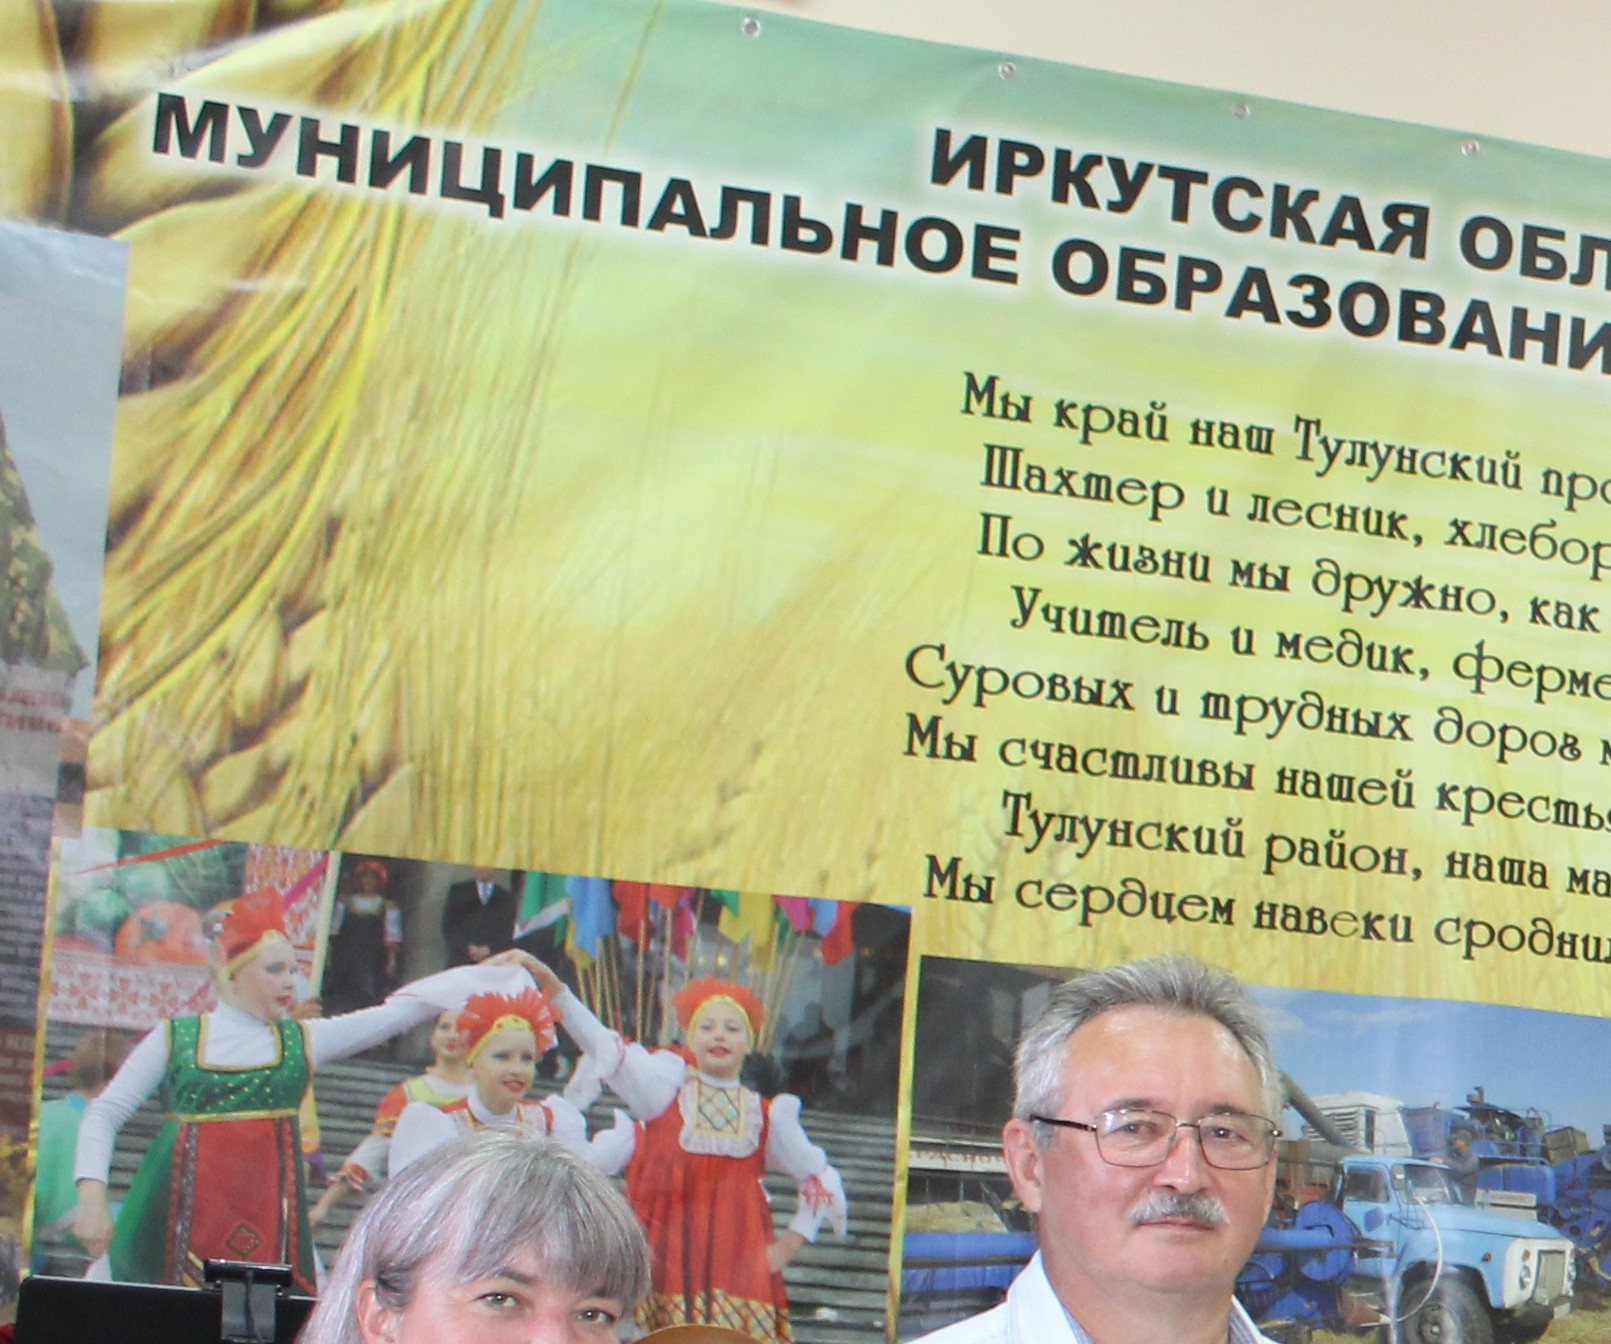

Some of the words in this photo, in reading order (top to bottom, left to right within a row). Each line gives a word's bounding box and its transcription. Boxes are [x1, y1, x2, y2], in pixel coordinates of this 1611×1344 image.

[153, 92, 1021, 286] МУНИЦИПАЛЬНОЕ
[930, 127, 1430, 261] ИРКУТСКАЯ
[960, 370, 1034, 424] Мы
[1052, 398, 1170, 447] край
[1188, 418, 1275, 456] наш
[1293, 413, 1523, 491] Тулунский
[979, 442, 1186, 523] Шахтер
[1205, 485, 1230, 518] и
[1246, 493, 1423, 548] лесник,
[976, 511, 1045, 562] По
[1063, 532, 1212, 584] жизни
[1228, 558, 1291, 593] мы
[1311, 557, 1509, 624] дружно,
[1528, 595, 1601, 634] как
[1009, 584, 1210, 652] Учитель
[1230, 625, 1256, 656] и
[1274, 627, 1430, 682] медик,
[904, 643, 1136, 712] Суровых
[1154, 684, 1180, 716] и
[1199, 690, 1414, 742] трудных
[902, 711, 978, 763] Мы
[998, 737, 1256, 791] счастливы
[1274, 765, 1416, 809] нашей
[1001, 788, 1246, 860] Тулунский
[1262, 828, 1423, 882] район,
[1444, 850, 1550, 890] наша
[923, 853, 996, 905] Мы
[1014, 877, 1236, 928] сердцем
[1252, 900, 1414, 943] навеки
